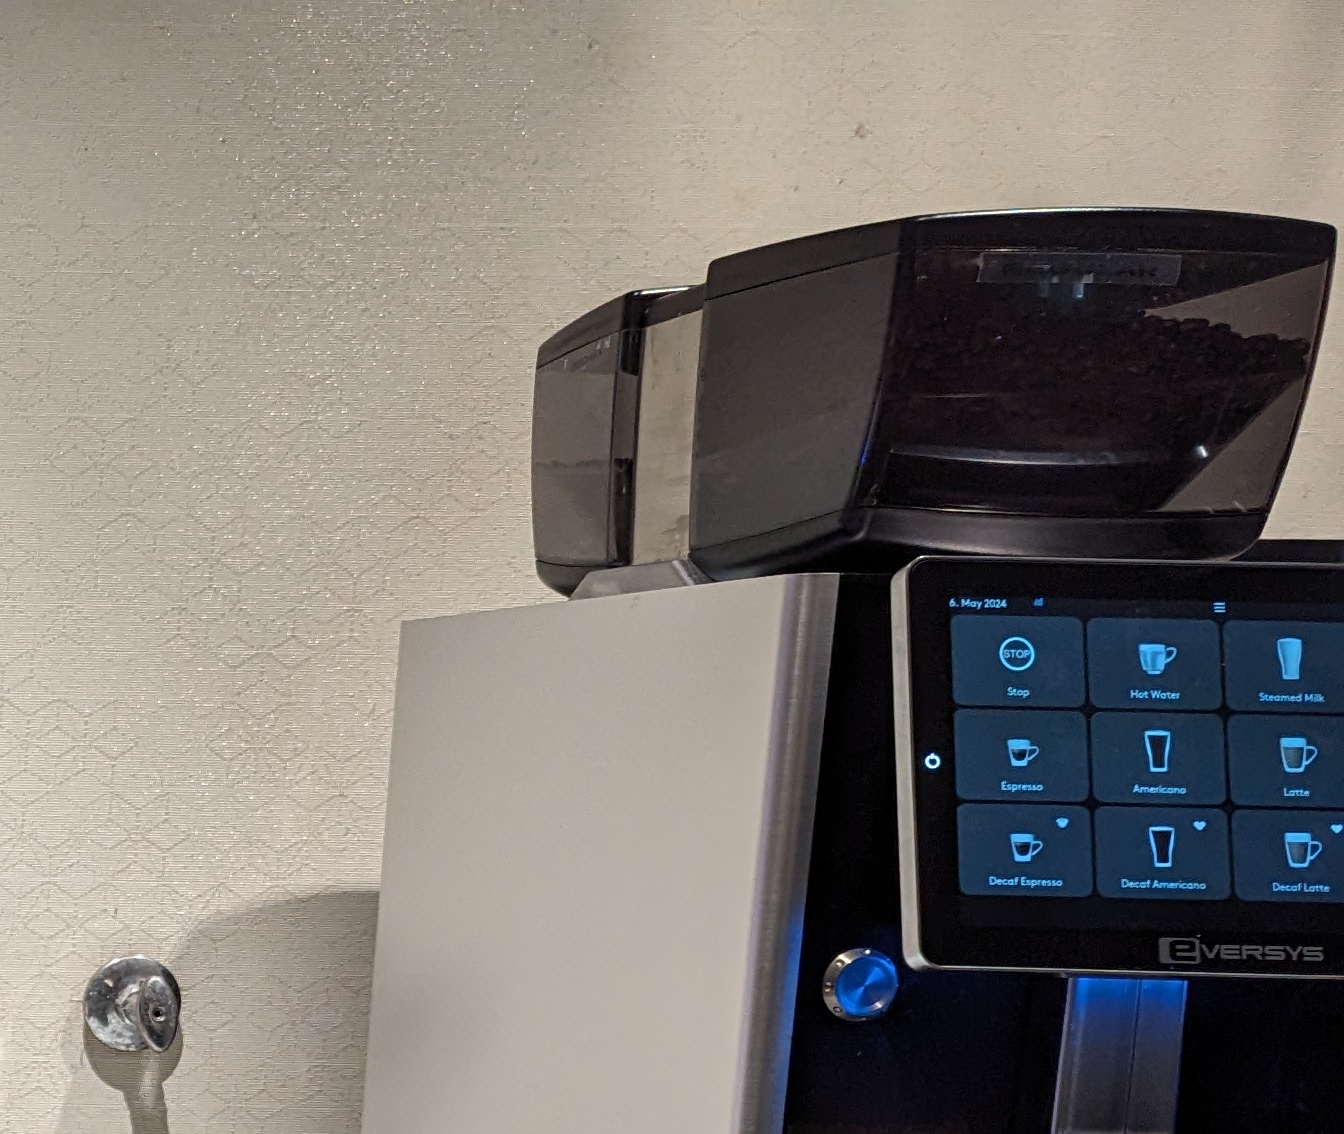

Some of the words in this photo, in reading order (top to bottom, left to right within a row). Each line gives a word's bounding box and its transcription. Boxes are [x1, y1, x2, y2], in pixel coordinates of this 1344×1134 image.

[961, 599, 982, 610] May
[983, 599, 1007, 609] 2024
[1003, 649, 1031, 659] STOP
[1007, 687, 1030, 699] Stop
[1130, 690, 1147, 699] Hot
[1149, 690, 1181, 700] Water
[1259, 692, 1302, 702] Steamed
[1304, 693, 1325, 703] Milk
[1001, 782, 1043, 793] Espresso
[1132, 785, 1187, 795] Americano
[1283, 788, 1310, 798] Latte
[988, 876, 1019, 886] Decaf
[1020, 877, 1063, 888] Espresso
[1121, 880, 1151, 889] Decaf
[1152, 880, 1206, 891] Americano
[1272, 882, 1302, 892] Decaf
[1303, 883, 1330, 893] Latte
